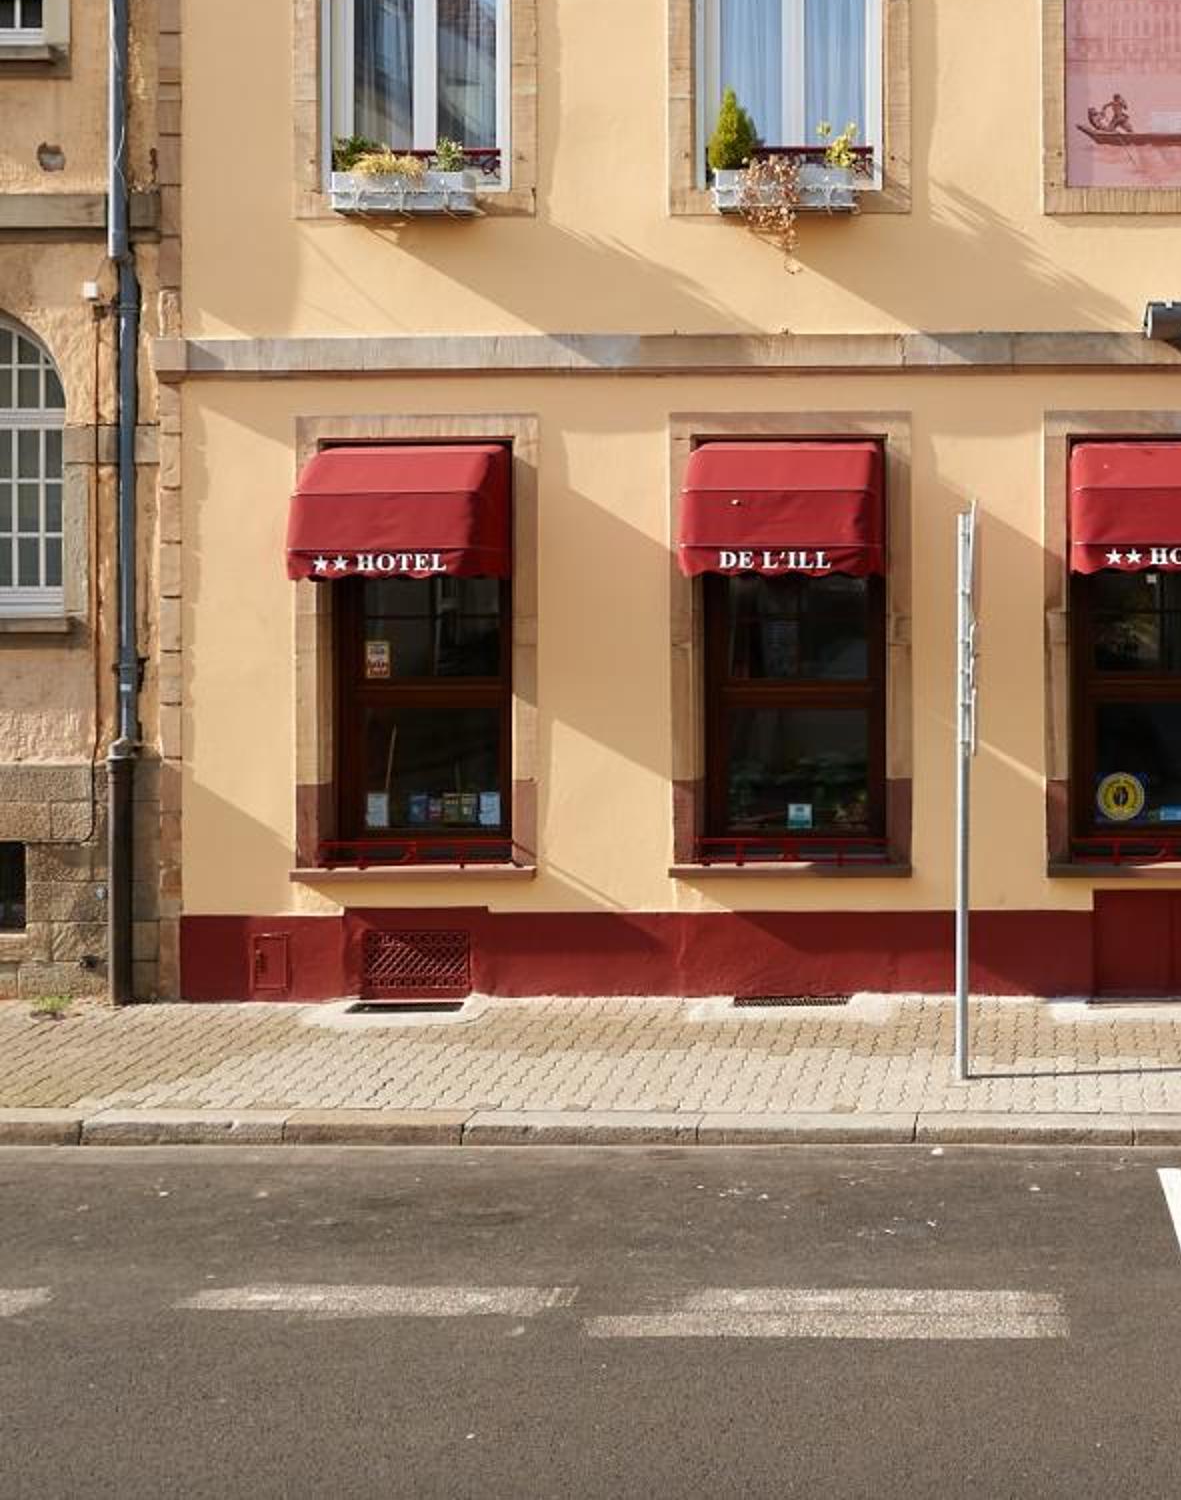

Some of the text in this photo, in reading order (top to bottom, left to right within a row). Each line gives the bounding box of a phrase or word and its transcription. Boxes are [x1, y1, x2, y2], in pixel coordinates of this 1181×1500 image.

[356, 552, 447, 571] HOTEL
[719, 550, 832, 569] DE L'ILL
